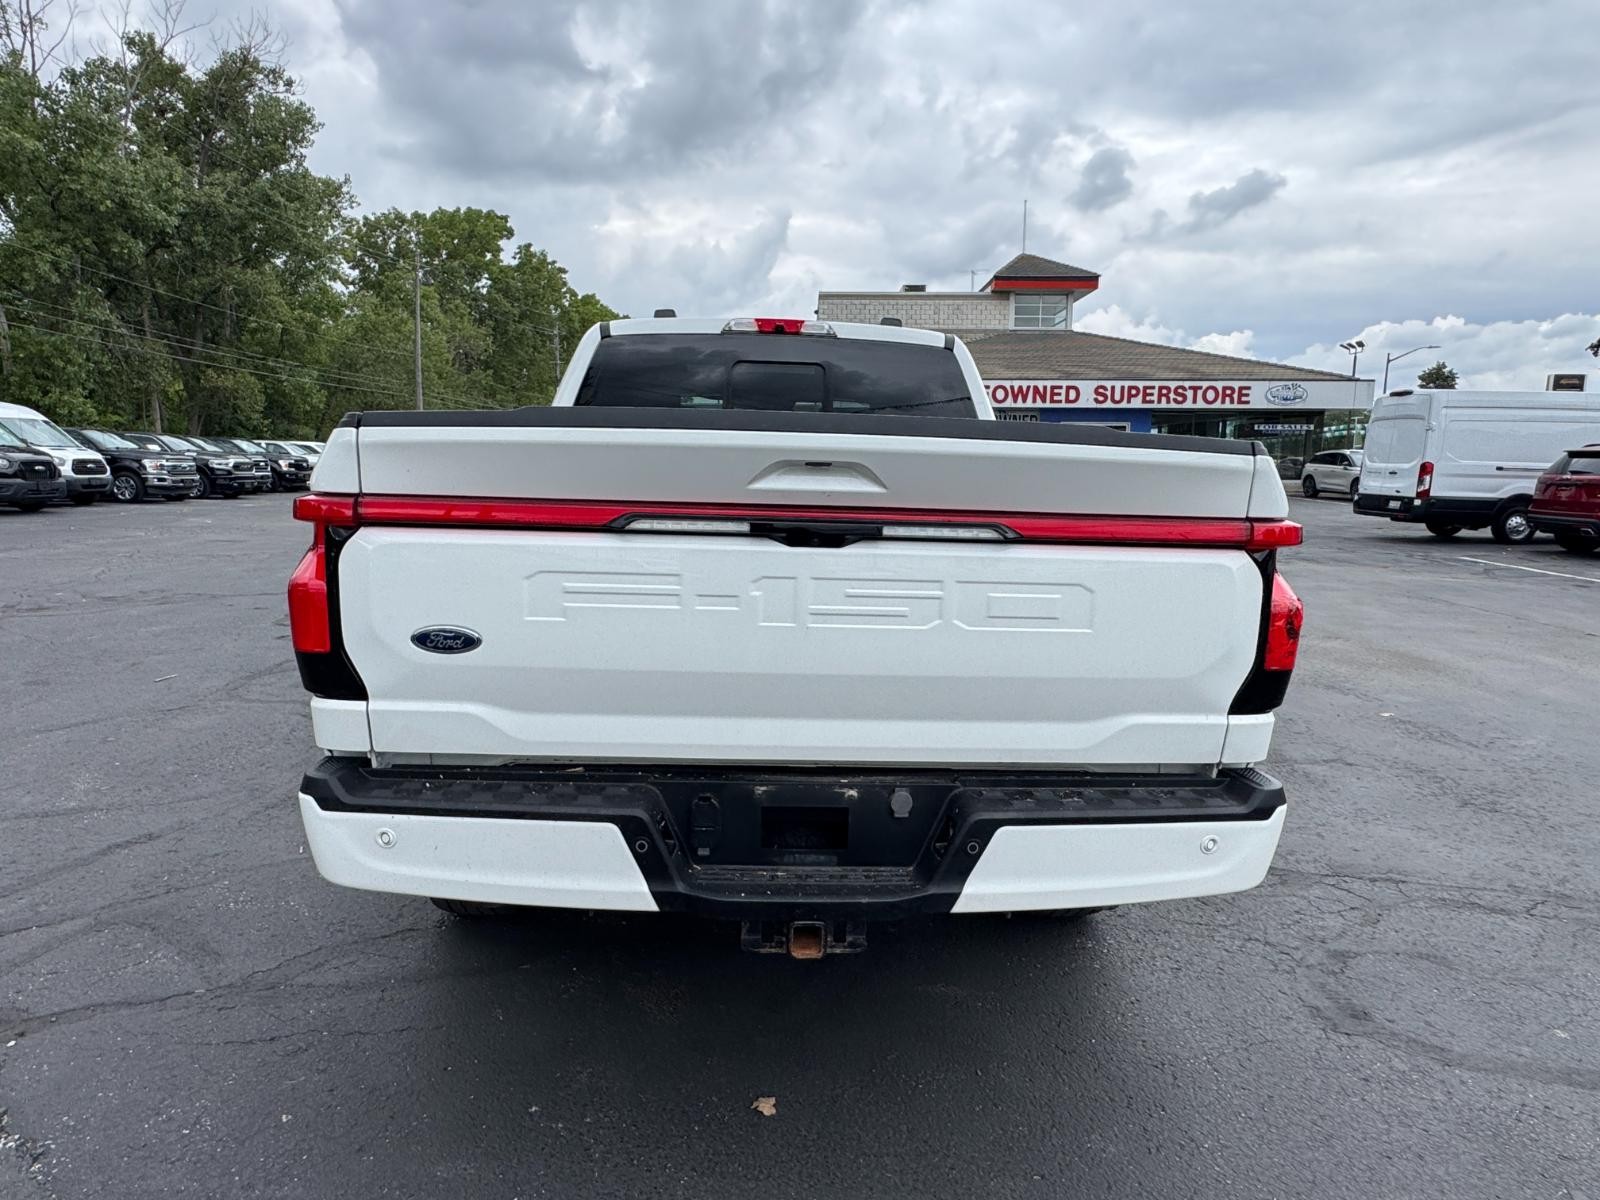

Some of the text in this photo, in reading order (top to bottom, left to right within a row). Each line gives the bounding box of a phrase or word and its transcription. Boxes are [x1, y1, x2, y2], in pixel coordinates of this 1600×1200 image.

[1093, 384, 1252, 405] SUPERSTORE
[522, 570, 1095, 634] F-150
[426, 631, 465, 648] Ford
